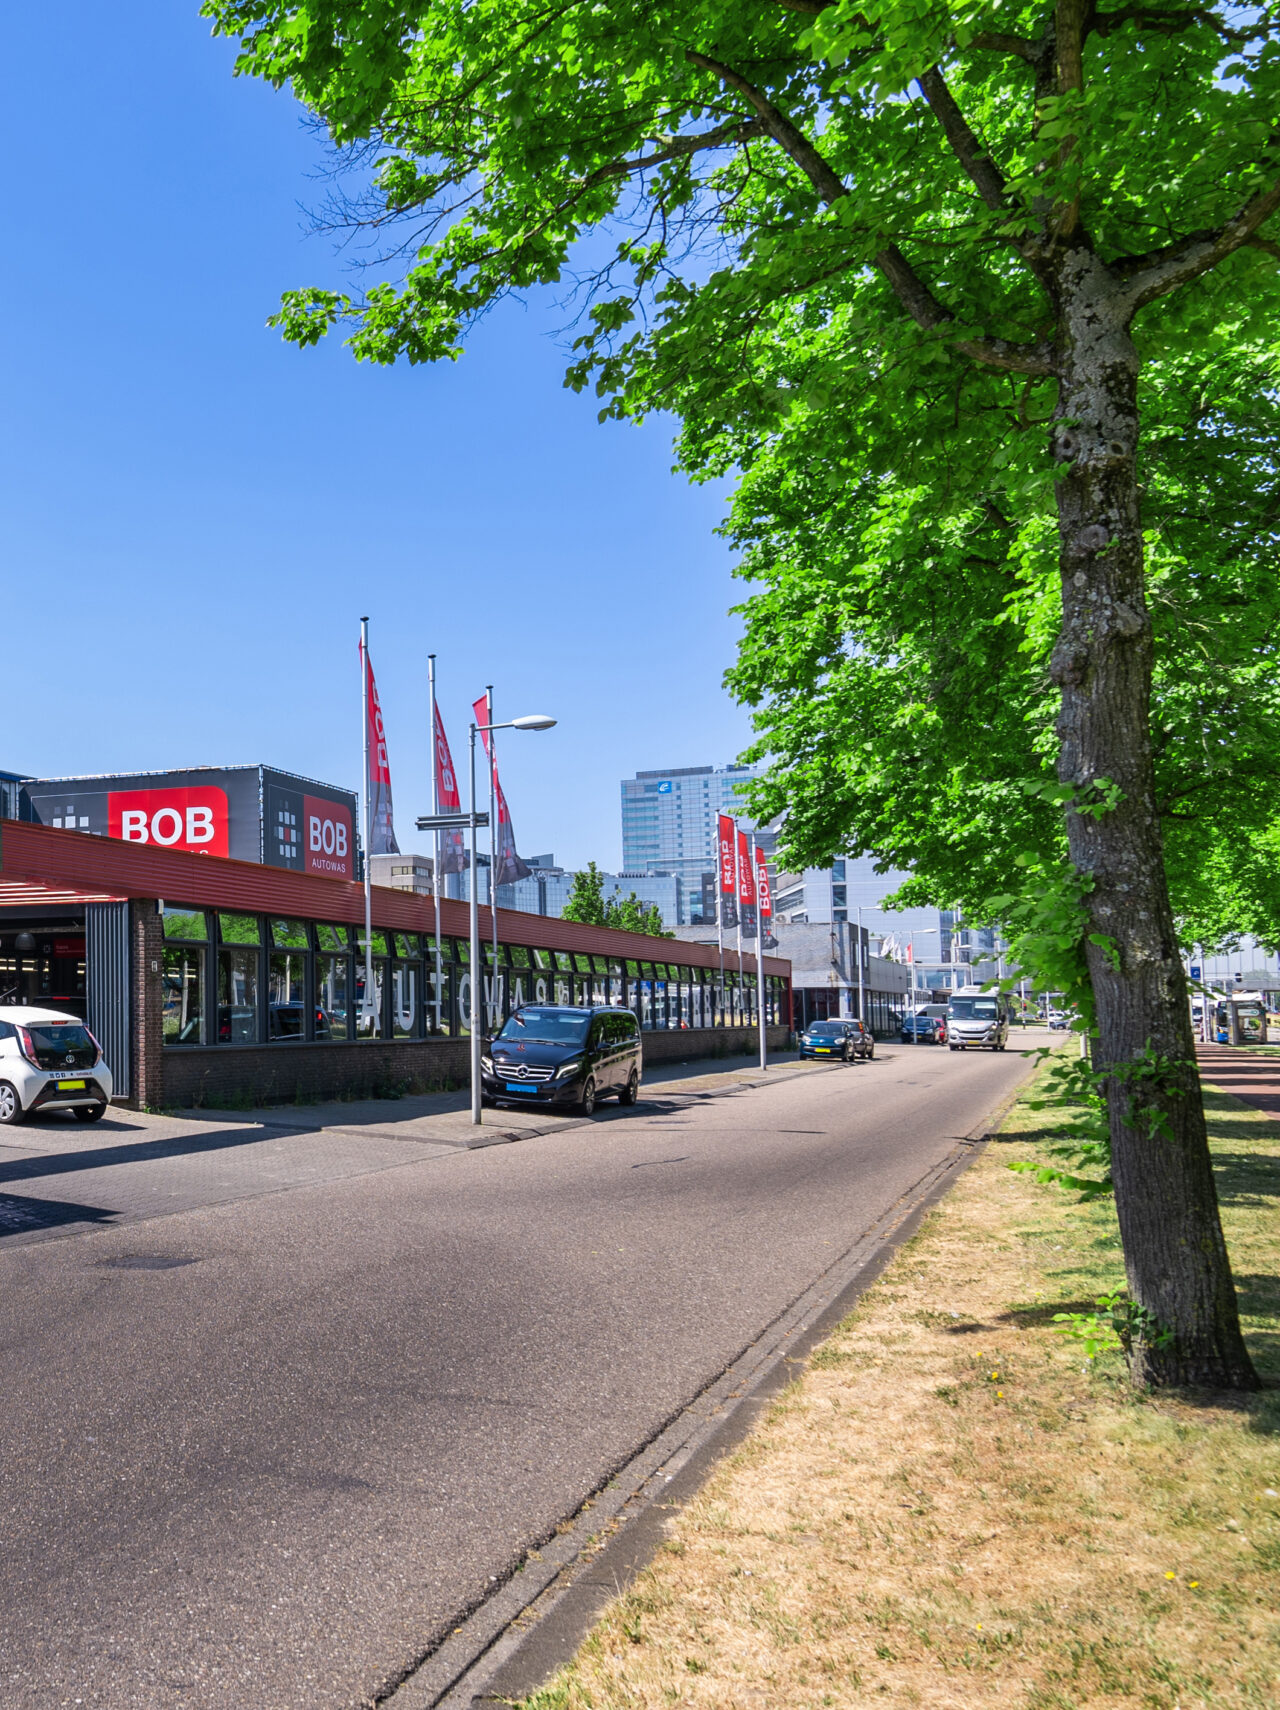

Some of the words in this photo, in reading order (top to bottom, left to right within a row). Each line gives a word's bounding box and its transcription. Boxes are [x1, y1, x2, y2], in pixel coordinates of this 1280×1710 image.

[122, 806, 215, 846] BOB
[309, 815, 348, 857] BOB
[311, 857, 346, 874] AUTOWAS
[759, 869, 770, 909] BOB
